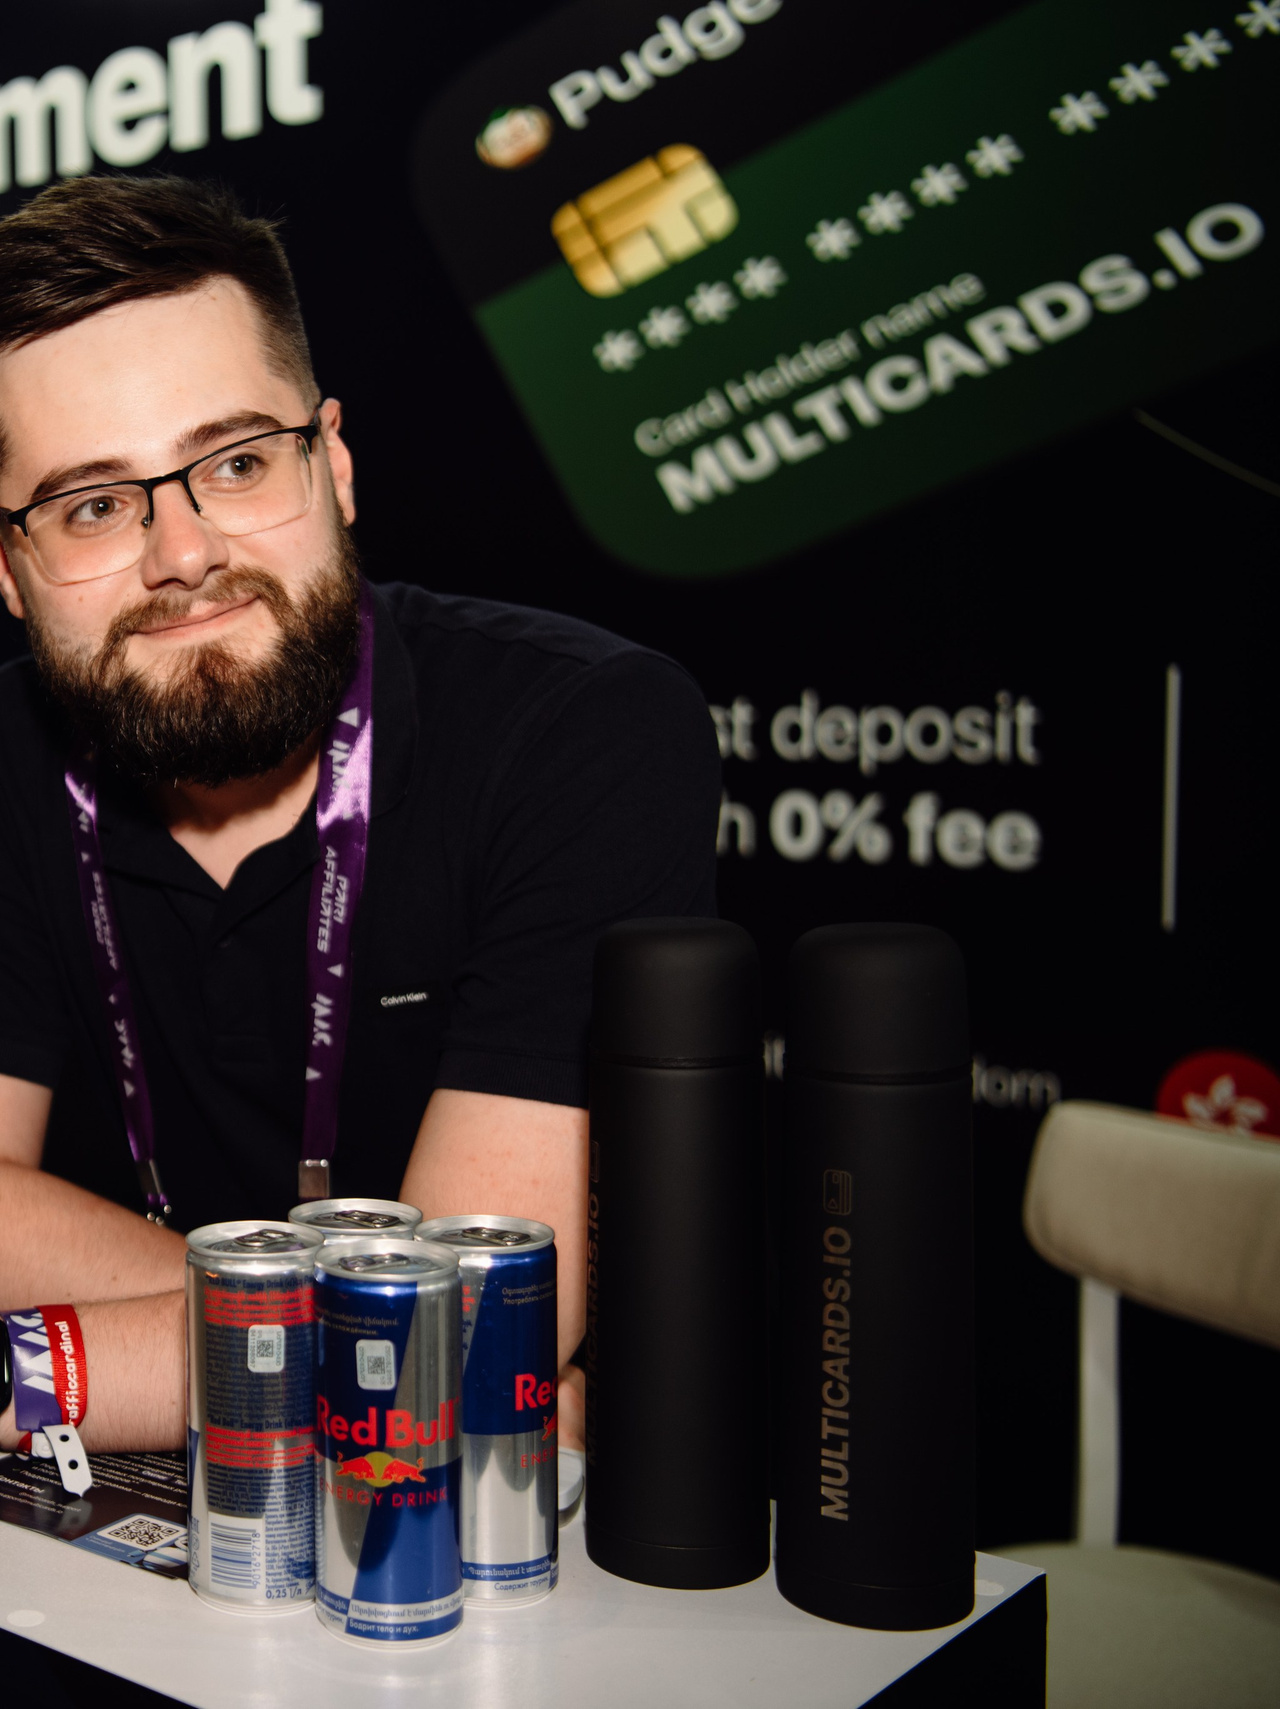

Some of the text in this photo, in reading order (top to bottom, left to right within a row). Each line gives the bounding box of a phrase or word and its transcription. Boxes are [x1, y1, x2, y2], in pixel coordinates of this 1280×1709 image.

[634, 272, 987, 457] Card Holder name
[654, 201, 1266, 514] MULTICARDS.IO
[770, 689, 1042, 777] deposit
[769, 788, 893, 865] 0%
[903, 792, 1043, 871] fee
[380, 992, 428, 1007] Calvin Klein
[821, 1227, 852, 1521] MULTICARDS.IO
[317, 1394, 454, 1447] Red Bull
[320, 1478, 383, 1506] ENERGY
[392, 1486, 448, 1507] DRINK
[266, 1589, 287, 1599] 0,25
[494, 1582, 528, 1592] Содержит
[349, 1618, 375, 1632] Бодрит
[377, 1624, 394, 1634] тело
[402, 1625, 419, 1635] дух.
